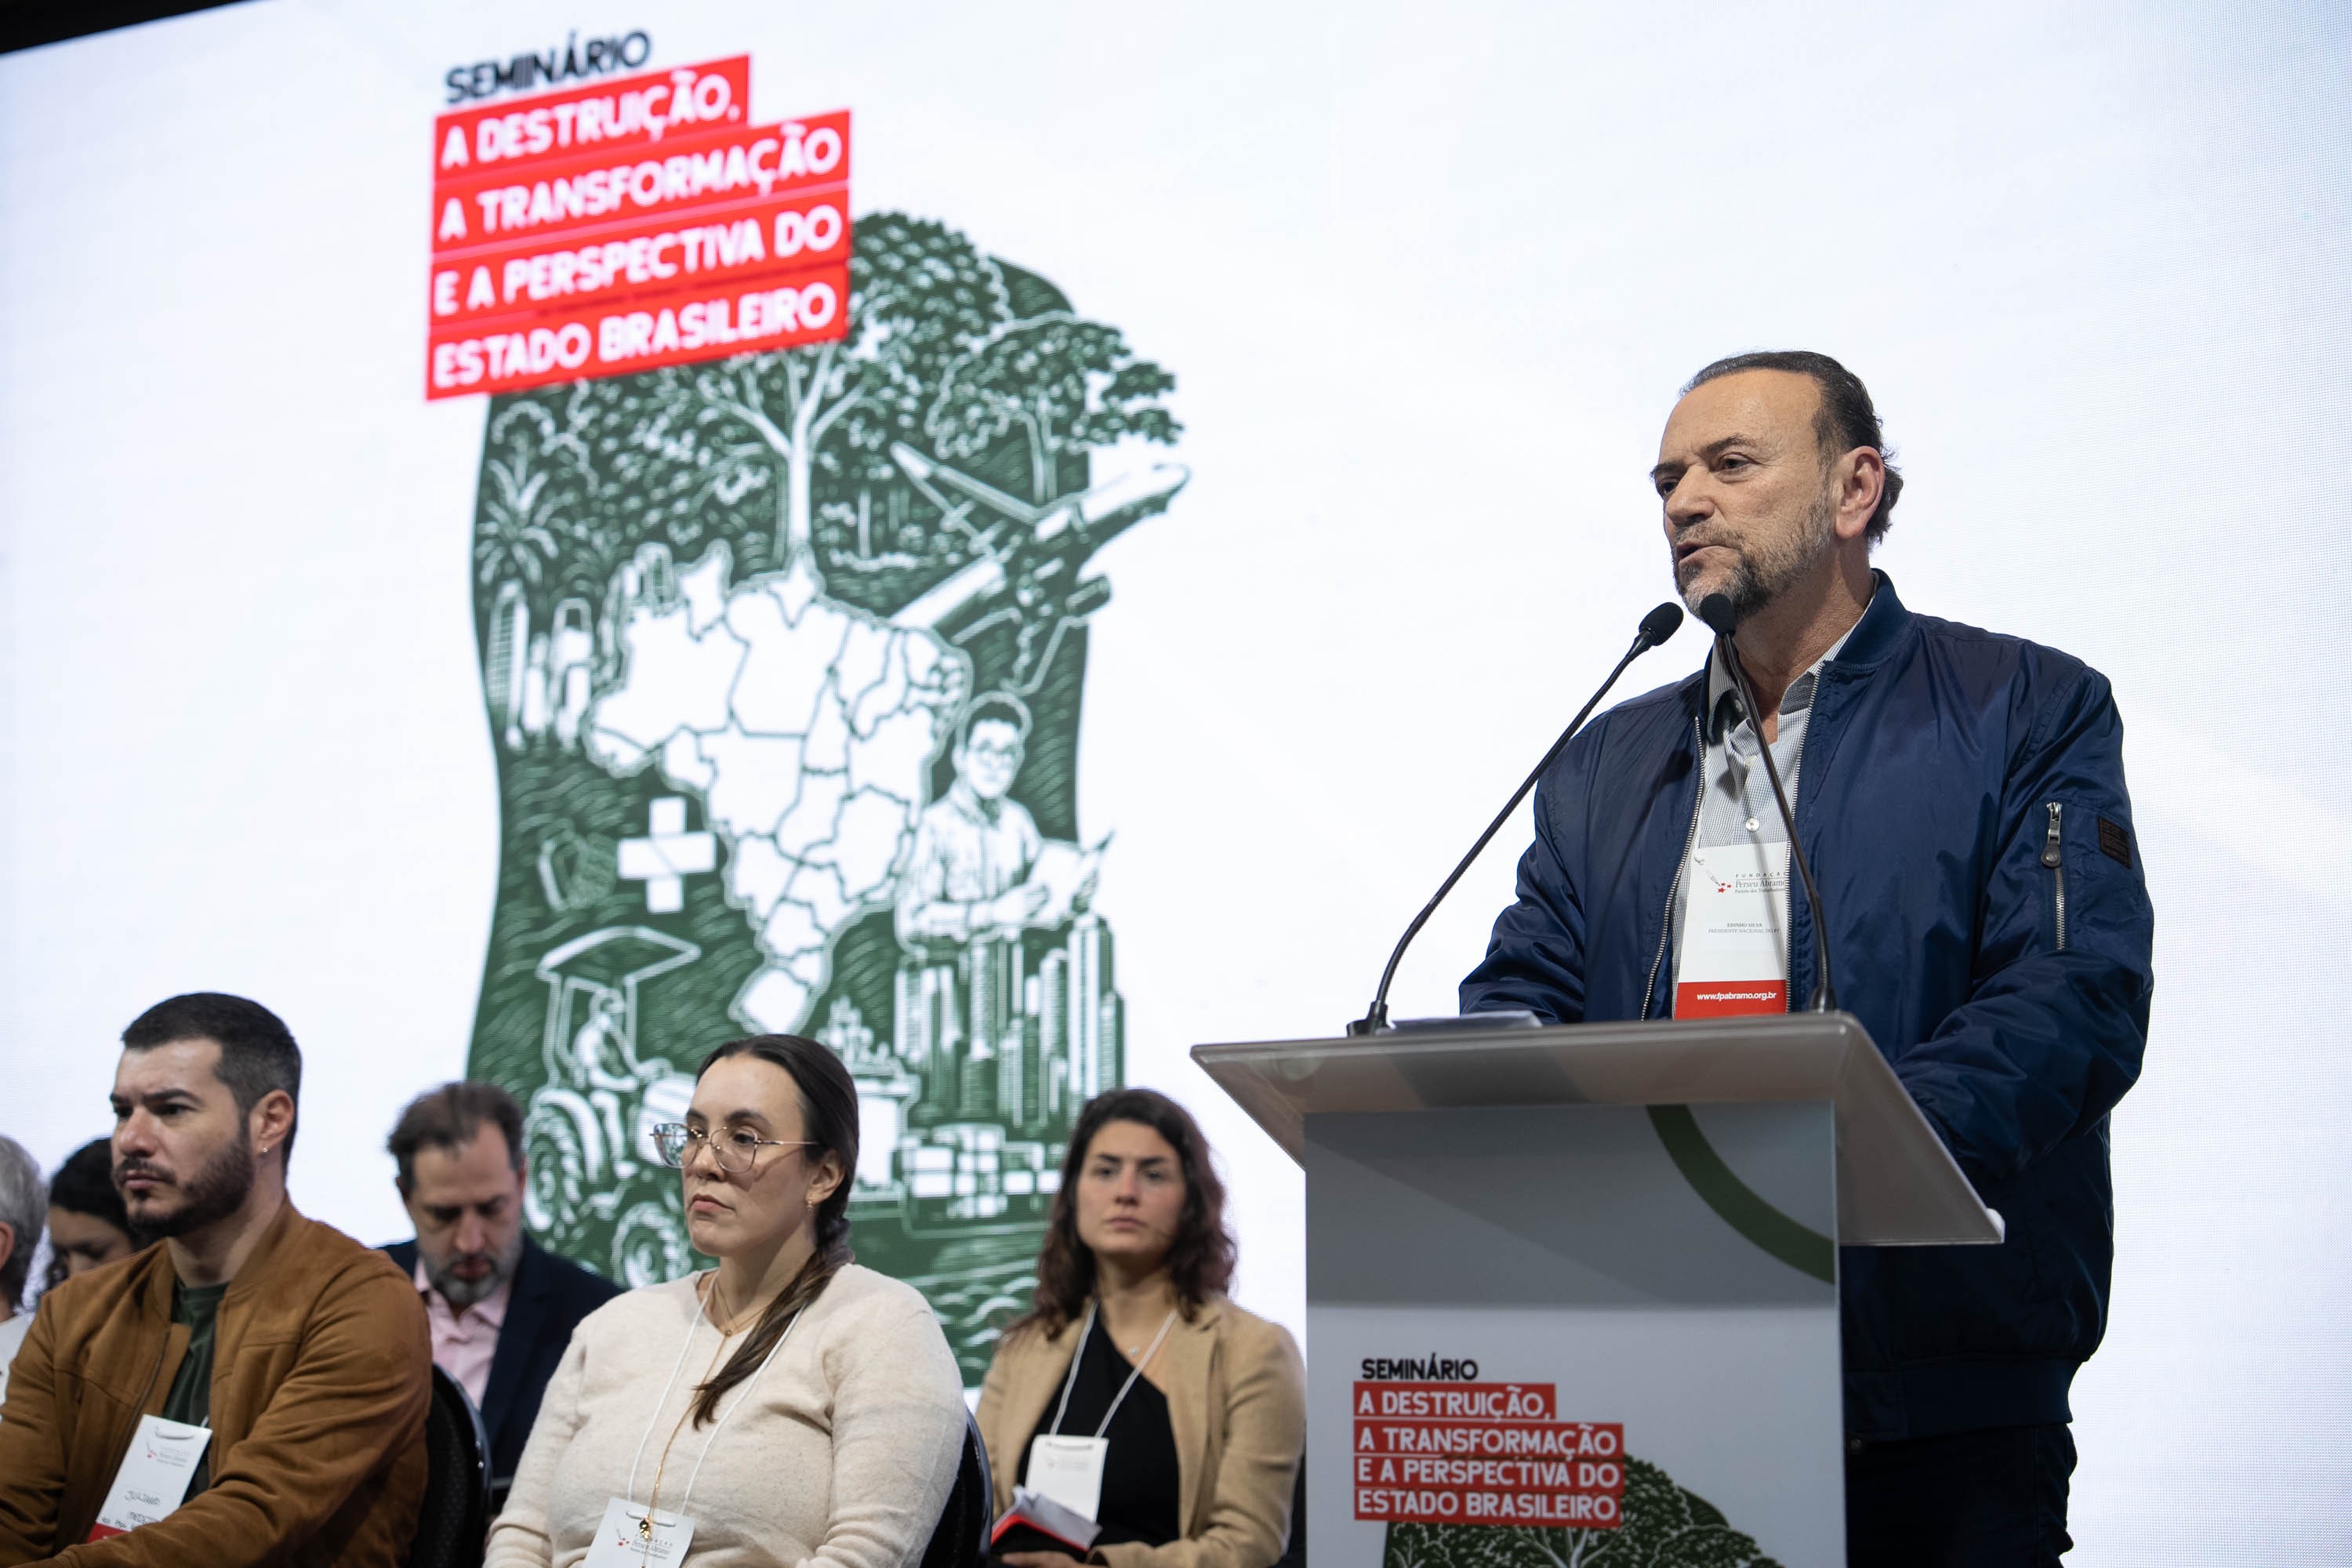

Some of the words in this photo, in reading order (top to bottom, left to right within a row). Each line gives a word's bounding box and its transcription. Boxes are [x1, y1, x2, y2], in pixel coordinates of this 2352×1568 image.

[445, 28, 652, 105] SEMINÁRIO
[440, 125, 469, 169] A
[476, 68, 741, 163] DESTRUIÇÃO,
[438, 197, 466, 241] A
[476, 121, 842, 234] TRANSFORMAÇÃO
[433, 270, 460, 315] E
[466, 267, 495, 310] A
[503, 218, 764, 303] PERSPECTIVA
[774, 204, 842, 257] DO
[433, 323, 592, 389] ESTADO
[597, 282, 837, 363] BRASILEIRO
[1697, 991, 1777, 1002] www.fpabramo.org.br
[1362, 1352, 1479, 1380] SEMINÁRIO
[1358, 1391, 1374, 1414] A
[1382, 1385, 1551, 1422] DESTRUIÇÃO,
[1359, 1427, 1374, 1450] A
[1383, 1423, 1617, 1461] TRANSFORMAÇÃO
[1359, 1458, 1372, 1483] E
[1381, 1459, 1396, 1483] A
[1404, 1459, 1570, 1487] PERSPECTIVA
[1580, 1463, 1619, 1488] DO
[1359, 1490, 1458, 1515] ESTADO
[1467, 1492, 1616, 1520] BRASILEIRO
